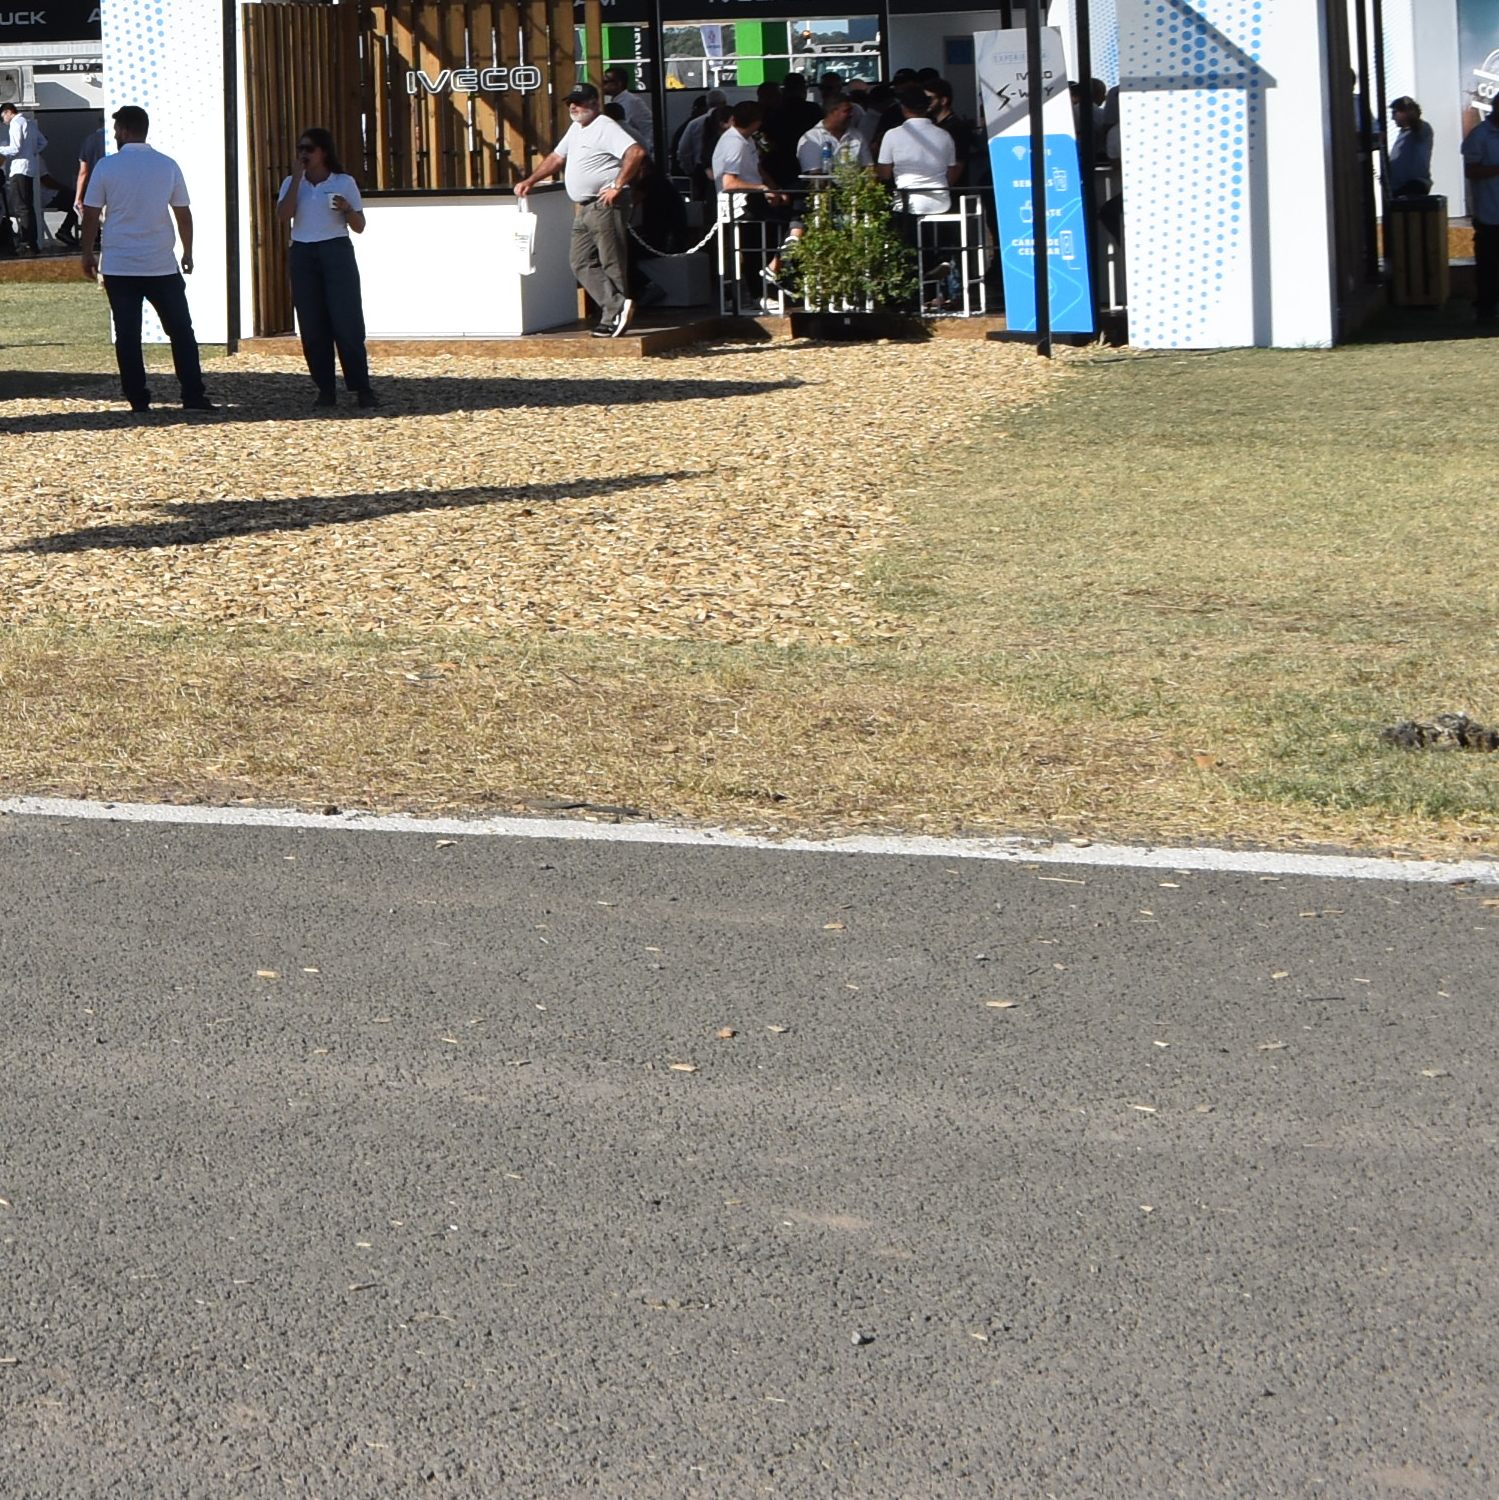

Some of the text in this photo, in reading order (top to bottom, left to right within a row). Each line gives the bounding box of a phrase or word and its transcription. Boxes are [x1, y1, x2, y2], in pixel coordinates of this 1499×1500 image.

[406, 66, 541, 94] IVECO
[1015, 70, 1053, 81] IVO
[996, 83, 1054, 111] S-WY
